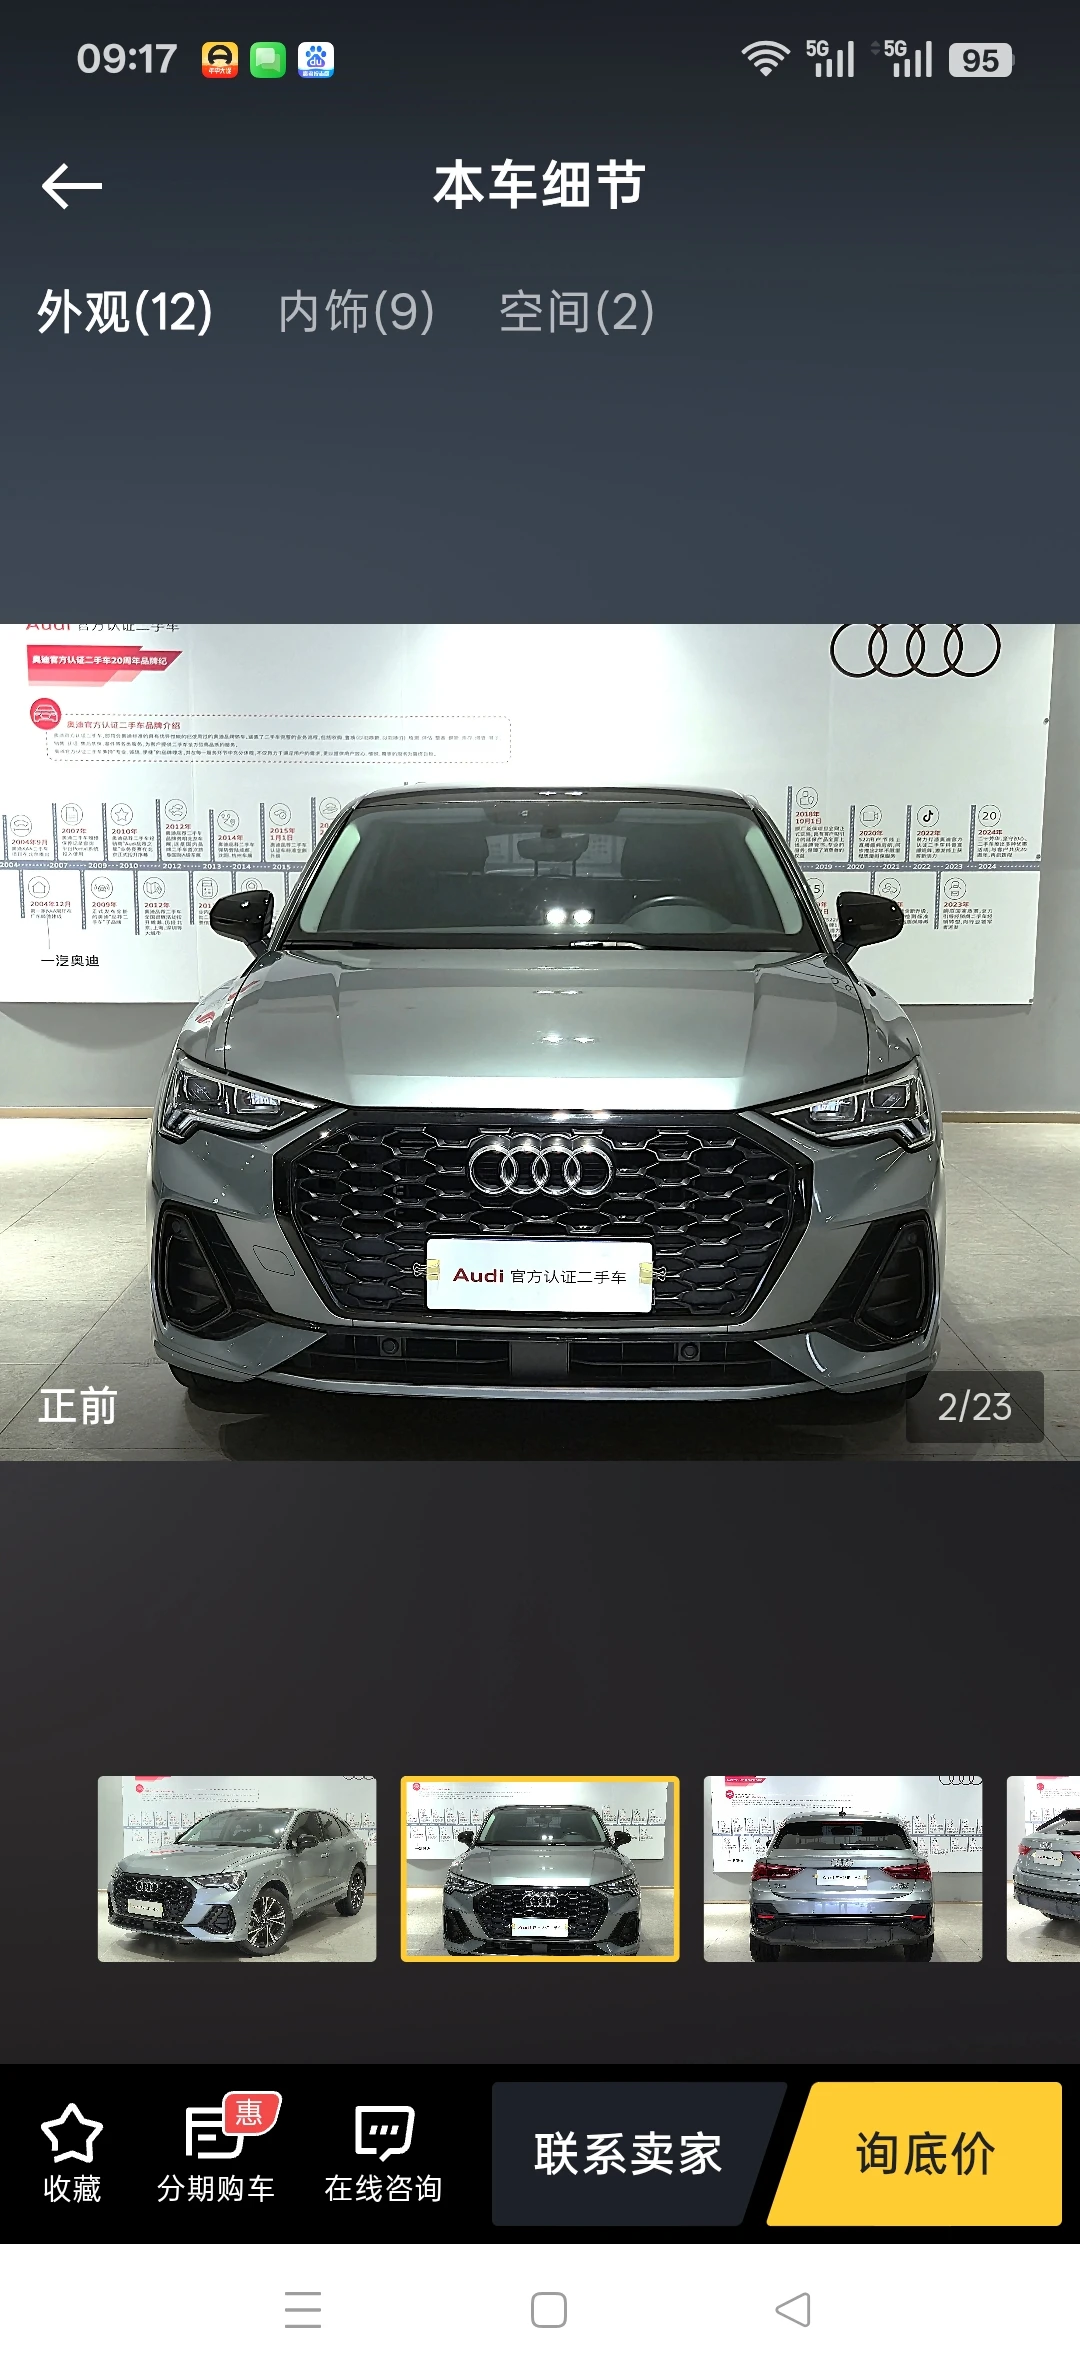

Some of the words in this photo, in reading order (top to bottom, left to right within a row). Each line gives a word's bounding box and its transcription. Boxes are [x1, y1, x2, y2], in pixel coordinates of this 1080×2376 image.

[76, 43, 178, 74] 09:17
[806, 40, 829, 57] 5G
[884, 40, 907, 57] 5G
[962, 48, 1000, 73] 95
[433, 158, 646, 210] 本车细节
[37, 289, 212, 336] 外观(12)
[280, 289, 434, 336] 内饰(9)
[500, 289, 654, 336] 空间(2)
[982, 811, 997, 821] 20
[40, 954, 100, 967] 一汽奥迪
[452, 1267, 504, 1283] Audi
[510, 1268, 627, 1285] 官方认证二手车
[235, 2098, 263, 2126] 惠
[534, 2131, 723, 2176] 联系卖家
[856, 2131, 996, 2177] 询底价
[43, 2174, 102, 2203] 收藏
[157, 2174, 275, 2203] 分期购车
[325, 2174, 442, 2203] 在线咨询
